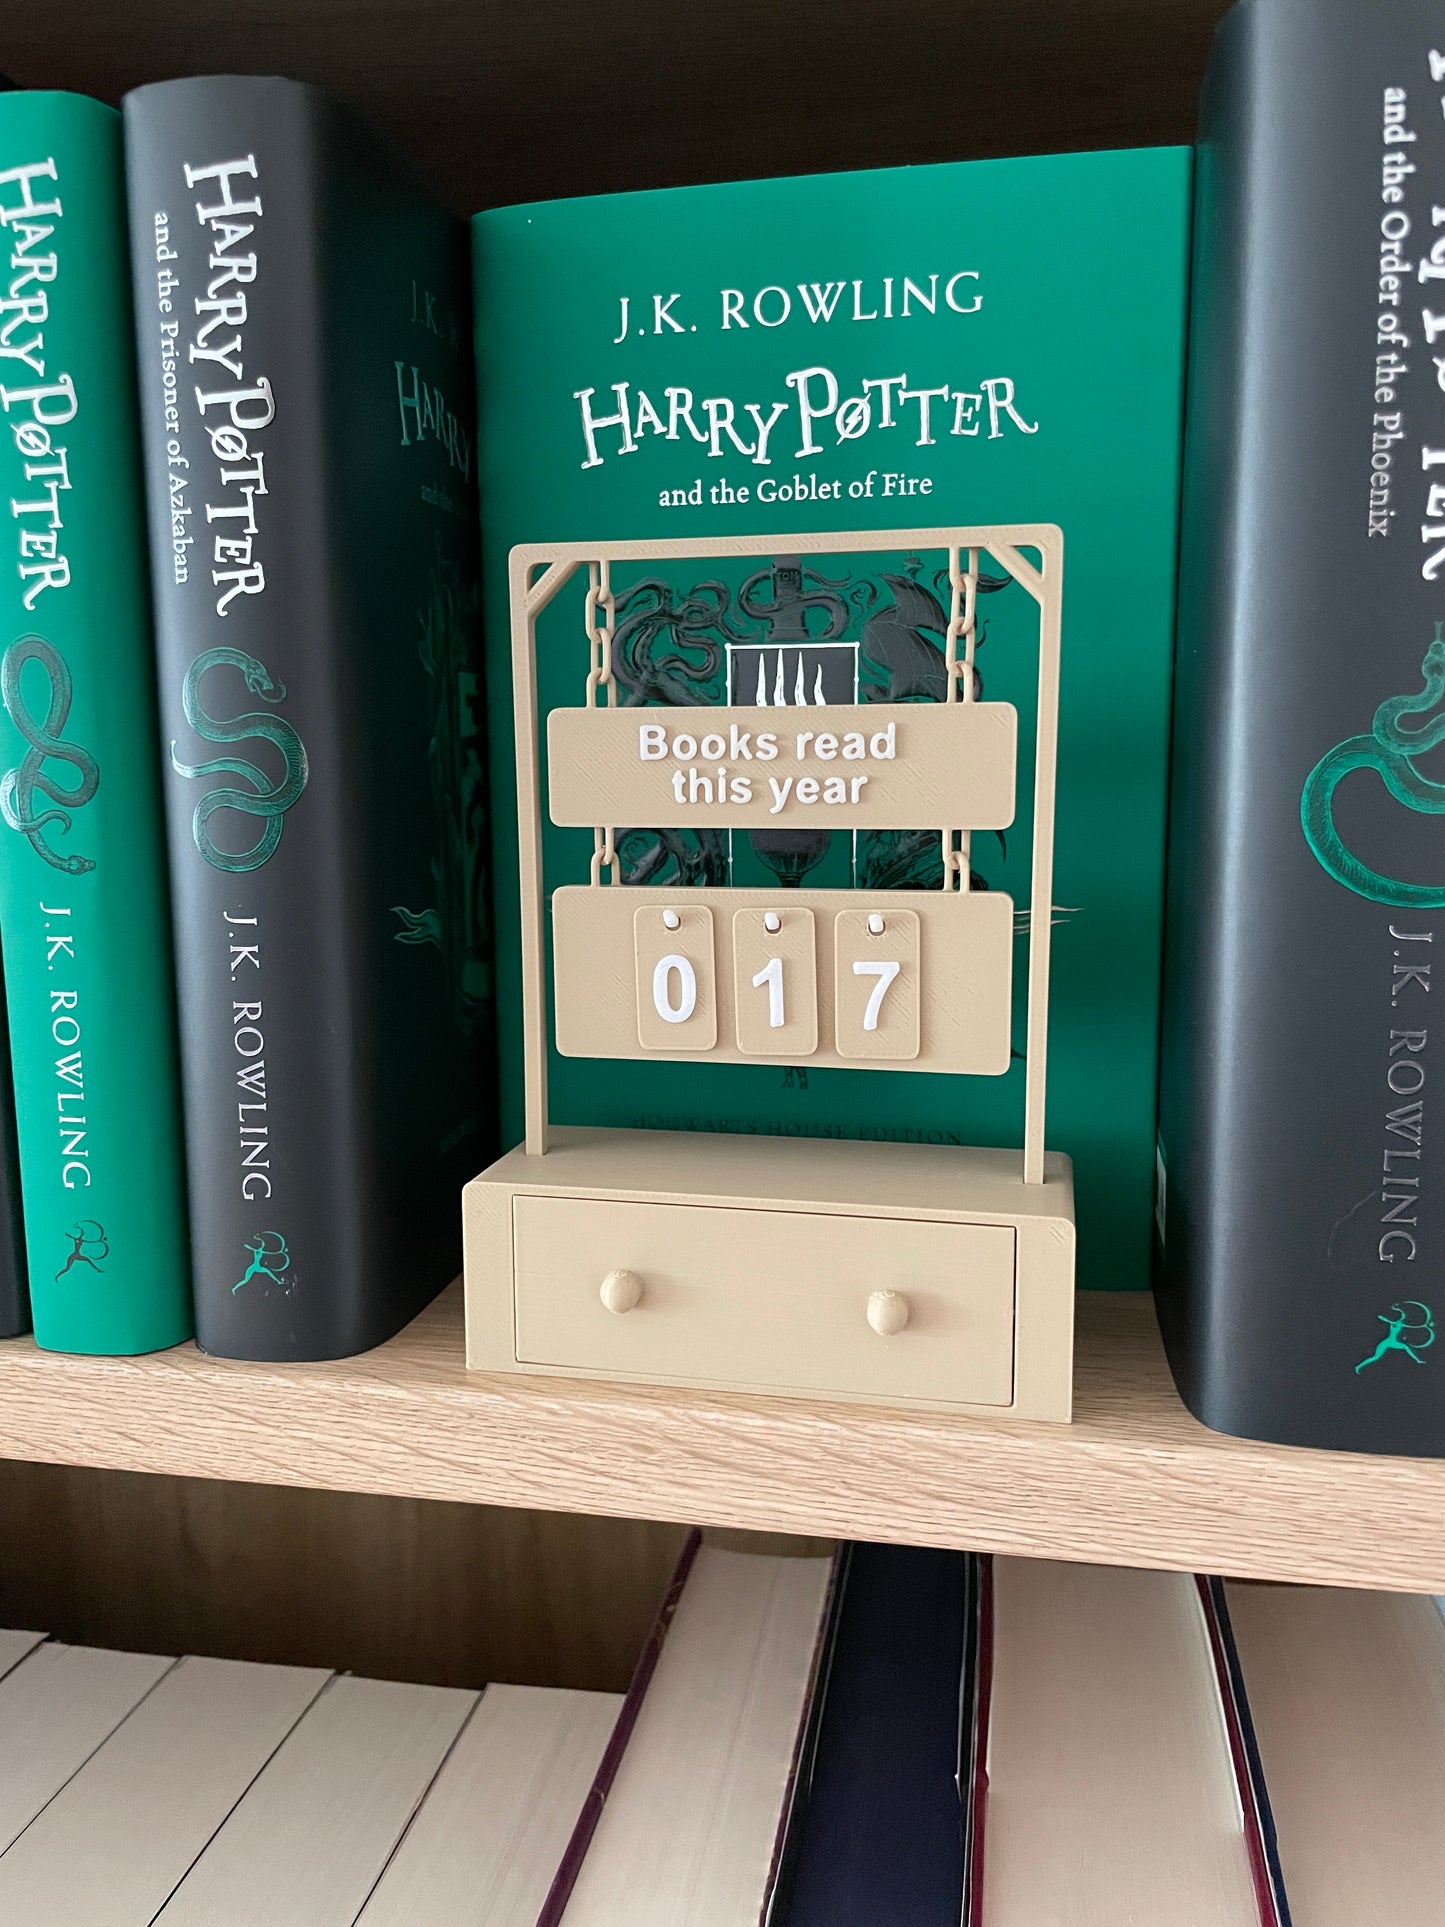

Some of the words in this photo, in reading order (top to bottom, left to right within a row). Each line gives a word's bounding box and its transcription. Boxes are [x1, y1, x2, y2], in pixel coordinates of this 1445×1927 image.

[1382, 87, 1417, 145] and
[1381, 151, 1416, 204] the
[0, 157, 63, 377] HARRY
[154, 212, 178, 263] and
[183, 154, 263, 381] HARRY
[1379, 210, 1413, 305] Order
[158, 268, 180, 313] the
[613, 294, 697, 344] J.K.
[721, 271, 984, 330] ROWLING
[1377, 313, 1411, 348] of
[161, 320, 180, 434] Prisoner
[1374, 353, 1408, 403] the
[167, 439, 190, 469] of
[573, 382, 789, 470] HARRY
[786, 367, 1039, 458] POTTER
[0, 374, 78, 610] POTTER
[195, 377, 275, 616] POTTER
[658, 480, 702, 507] and
[710, 477, 750, 504] the
[756, 474, 842, 502] Goblet
[851, 471, 877, 498] of
[881, 471, 933, 496] Fire
[1368, 411, 1404, 537] Phoenix
[169, 472, 195, 586] Azkaban
[638, 723, 778, 761] Books
[796, 722, 896, 760] read
[671, 767, 753, 804] this
[768, 775, 869, 814] year
[39, 901, 76, 971] J.K.
[223, 910, 260, 982] J.K.
[1388, 925, 1433, 1007] J.K.
[49, 990, 91, 1190] ROWLING
[232, 1001, 271, 1201] ROWLING
[768, 1120, 848, 1139] HOUSE
[859, 1126, 962, 1146] EDITION
[1378, 1029, 1428, 1263] ROWLING
